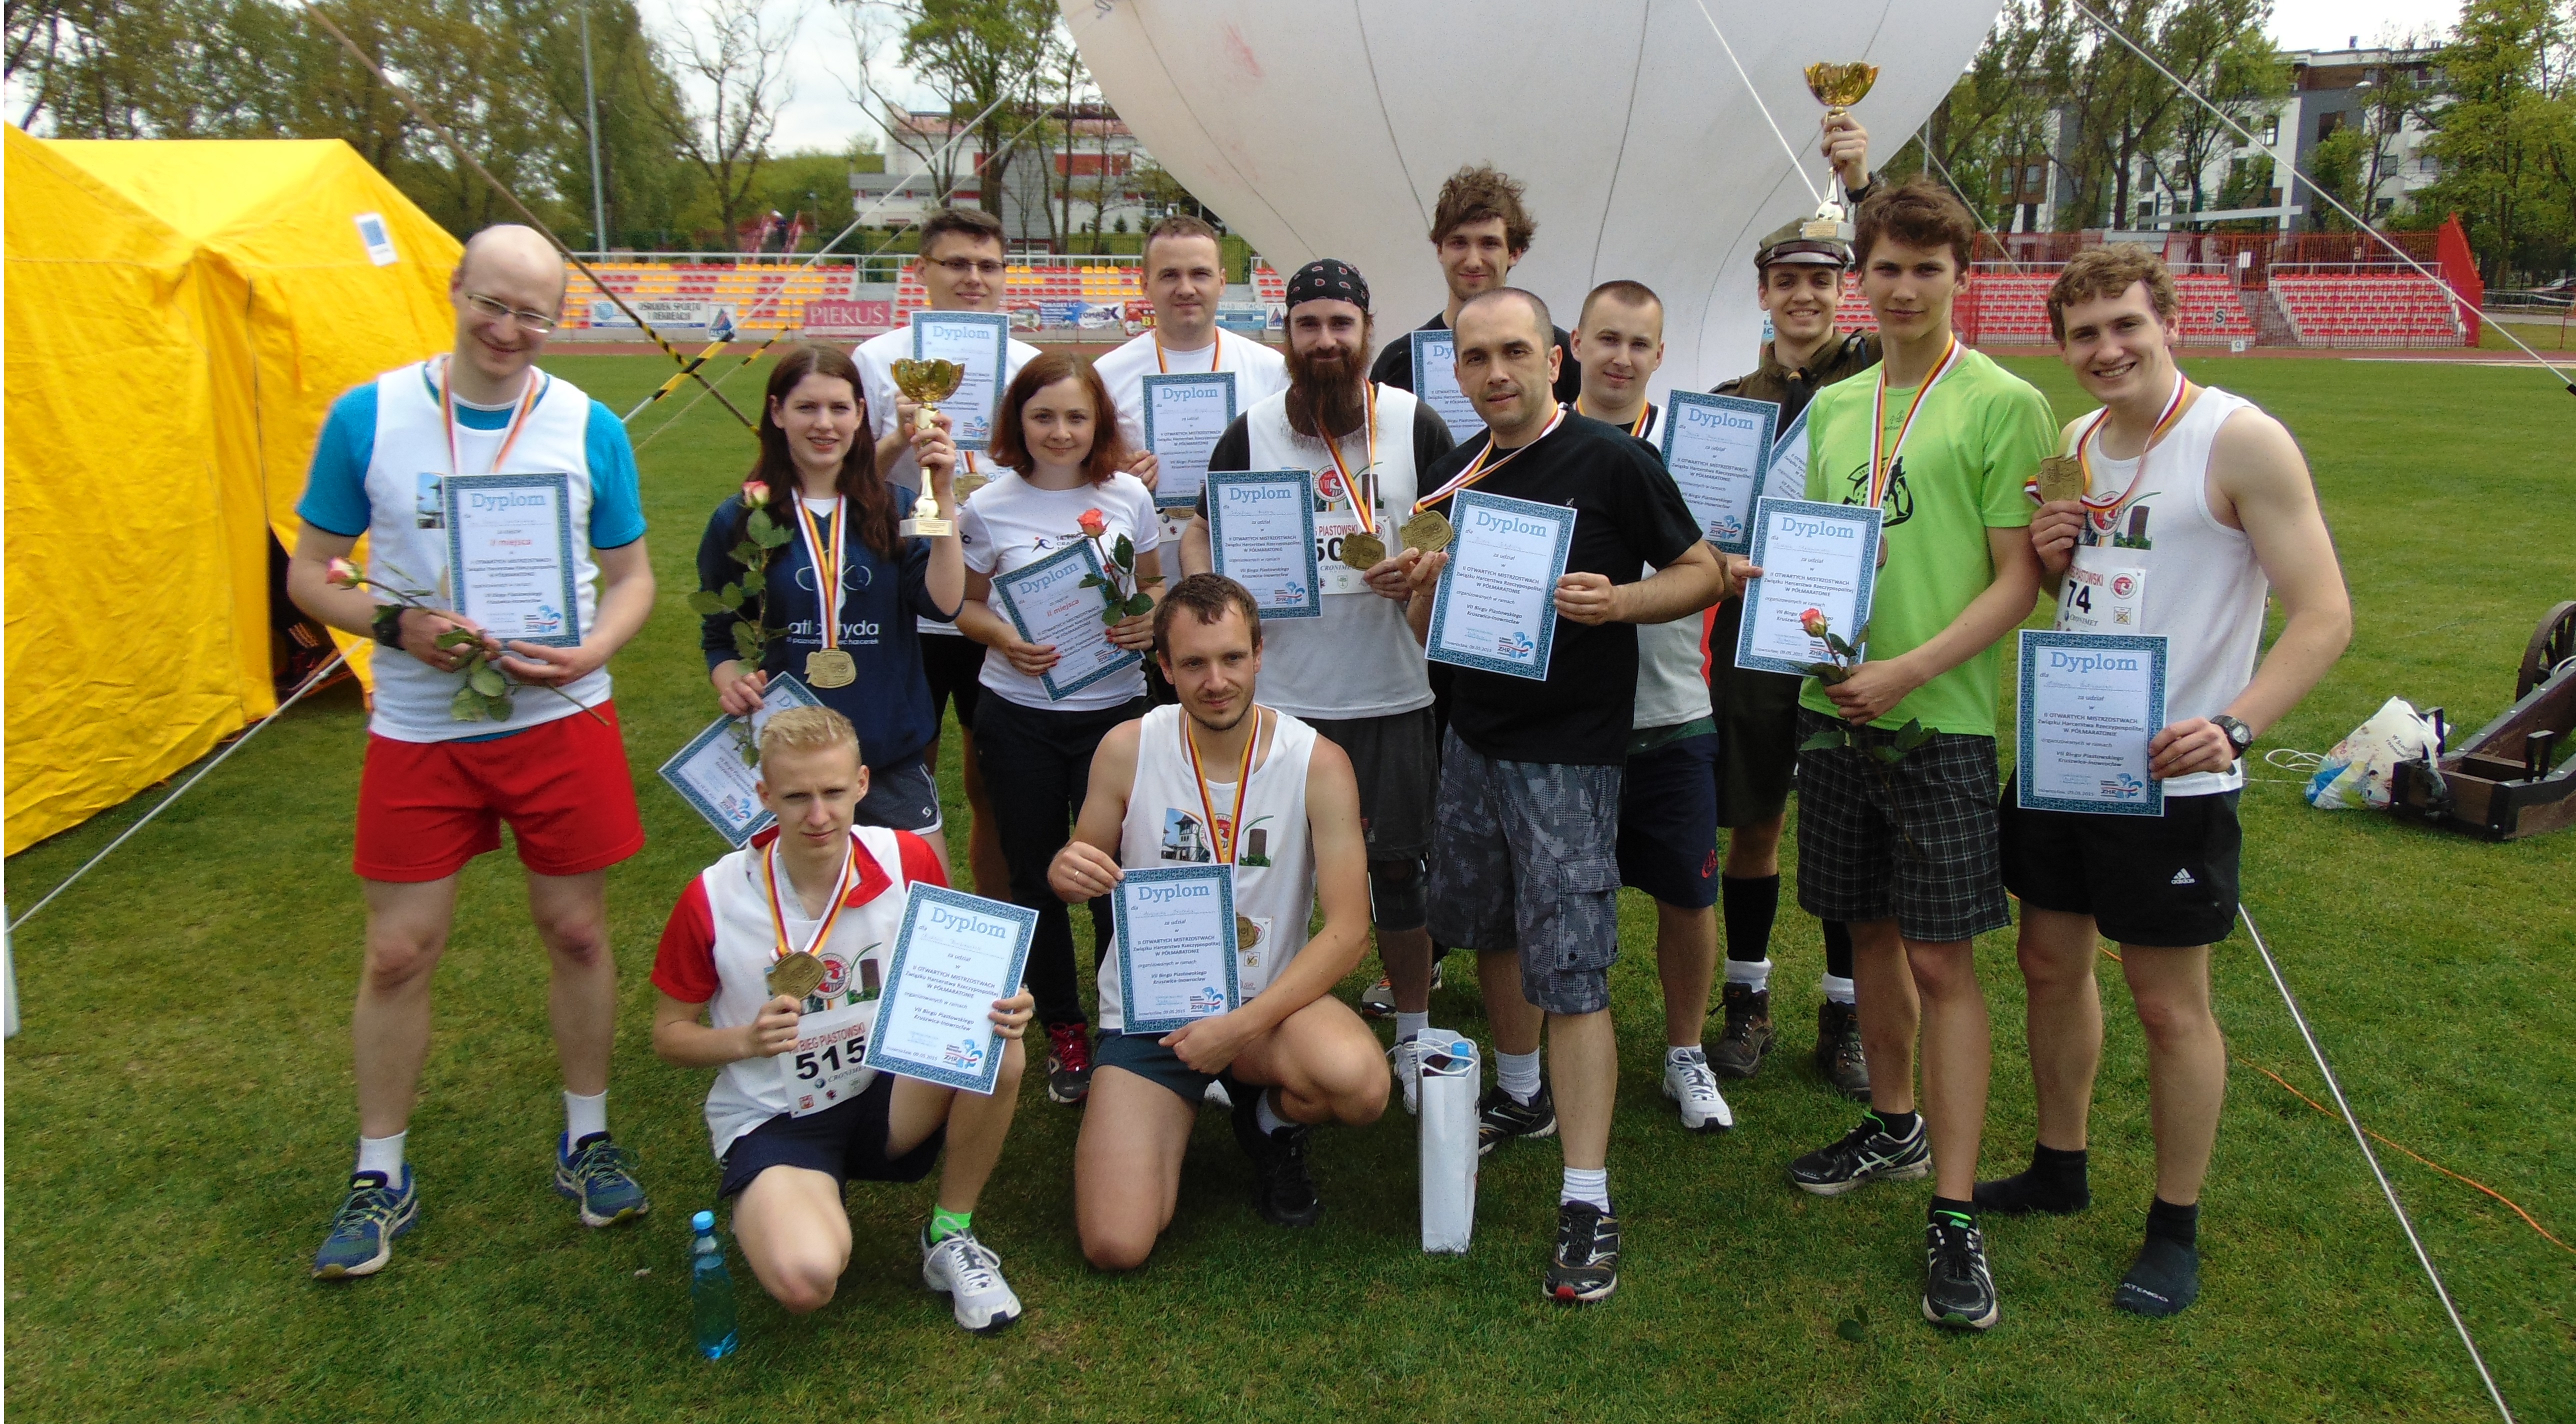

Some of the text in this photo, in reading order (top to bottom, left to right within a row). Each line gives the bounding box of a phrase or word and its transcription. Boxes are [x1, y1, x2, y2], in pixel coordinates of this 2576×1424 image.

[2216, 310, 2224, 322] S
[933, 326, 990, 340] Dyplom
[1162, 386, 1218, 402] Dyplom
[1688, 408, 1752, 430] Dyplom
[470, 492, 546, 512] Dyplom
[1228, 486, 1292, 502] Dyplom
[1319, 524, 1358, 536] PIASTOWSKI
[1476, 510, 1546, 536] Dyplom
[1782, 517, 1854, 538] Dyplom
[1018, 563, 1079, 594] Dyplom
[1466, 566, 1496, 576] OTWARTYCH
[1497, 572, 1539, 584] MISTRZOSTWACH
[1054, 600, 1080, 614] miejsca
[788, 620, 879, 638] atltyda
[2070, 614, 2098, 626] CRONIMET
[2050, 652, 2138, 672] Dyplom
[1139, 884, 1210, 902] Dyplom
[931, 906, 1005, 938] Dyplom
[820, 1022, 865, 1046] PIASTOWSKI
[796, 1036, 866, 1080] 515
[828, 1066, 866, 1082] CRONIME
